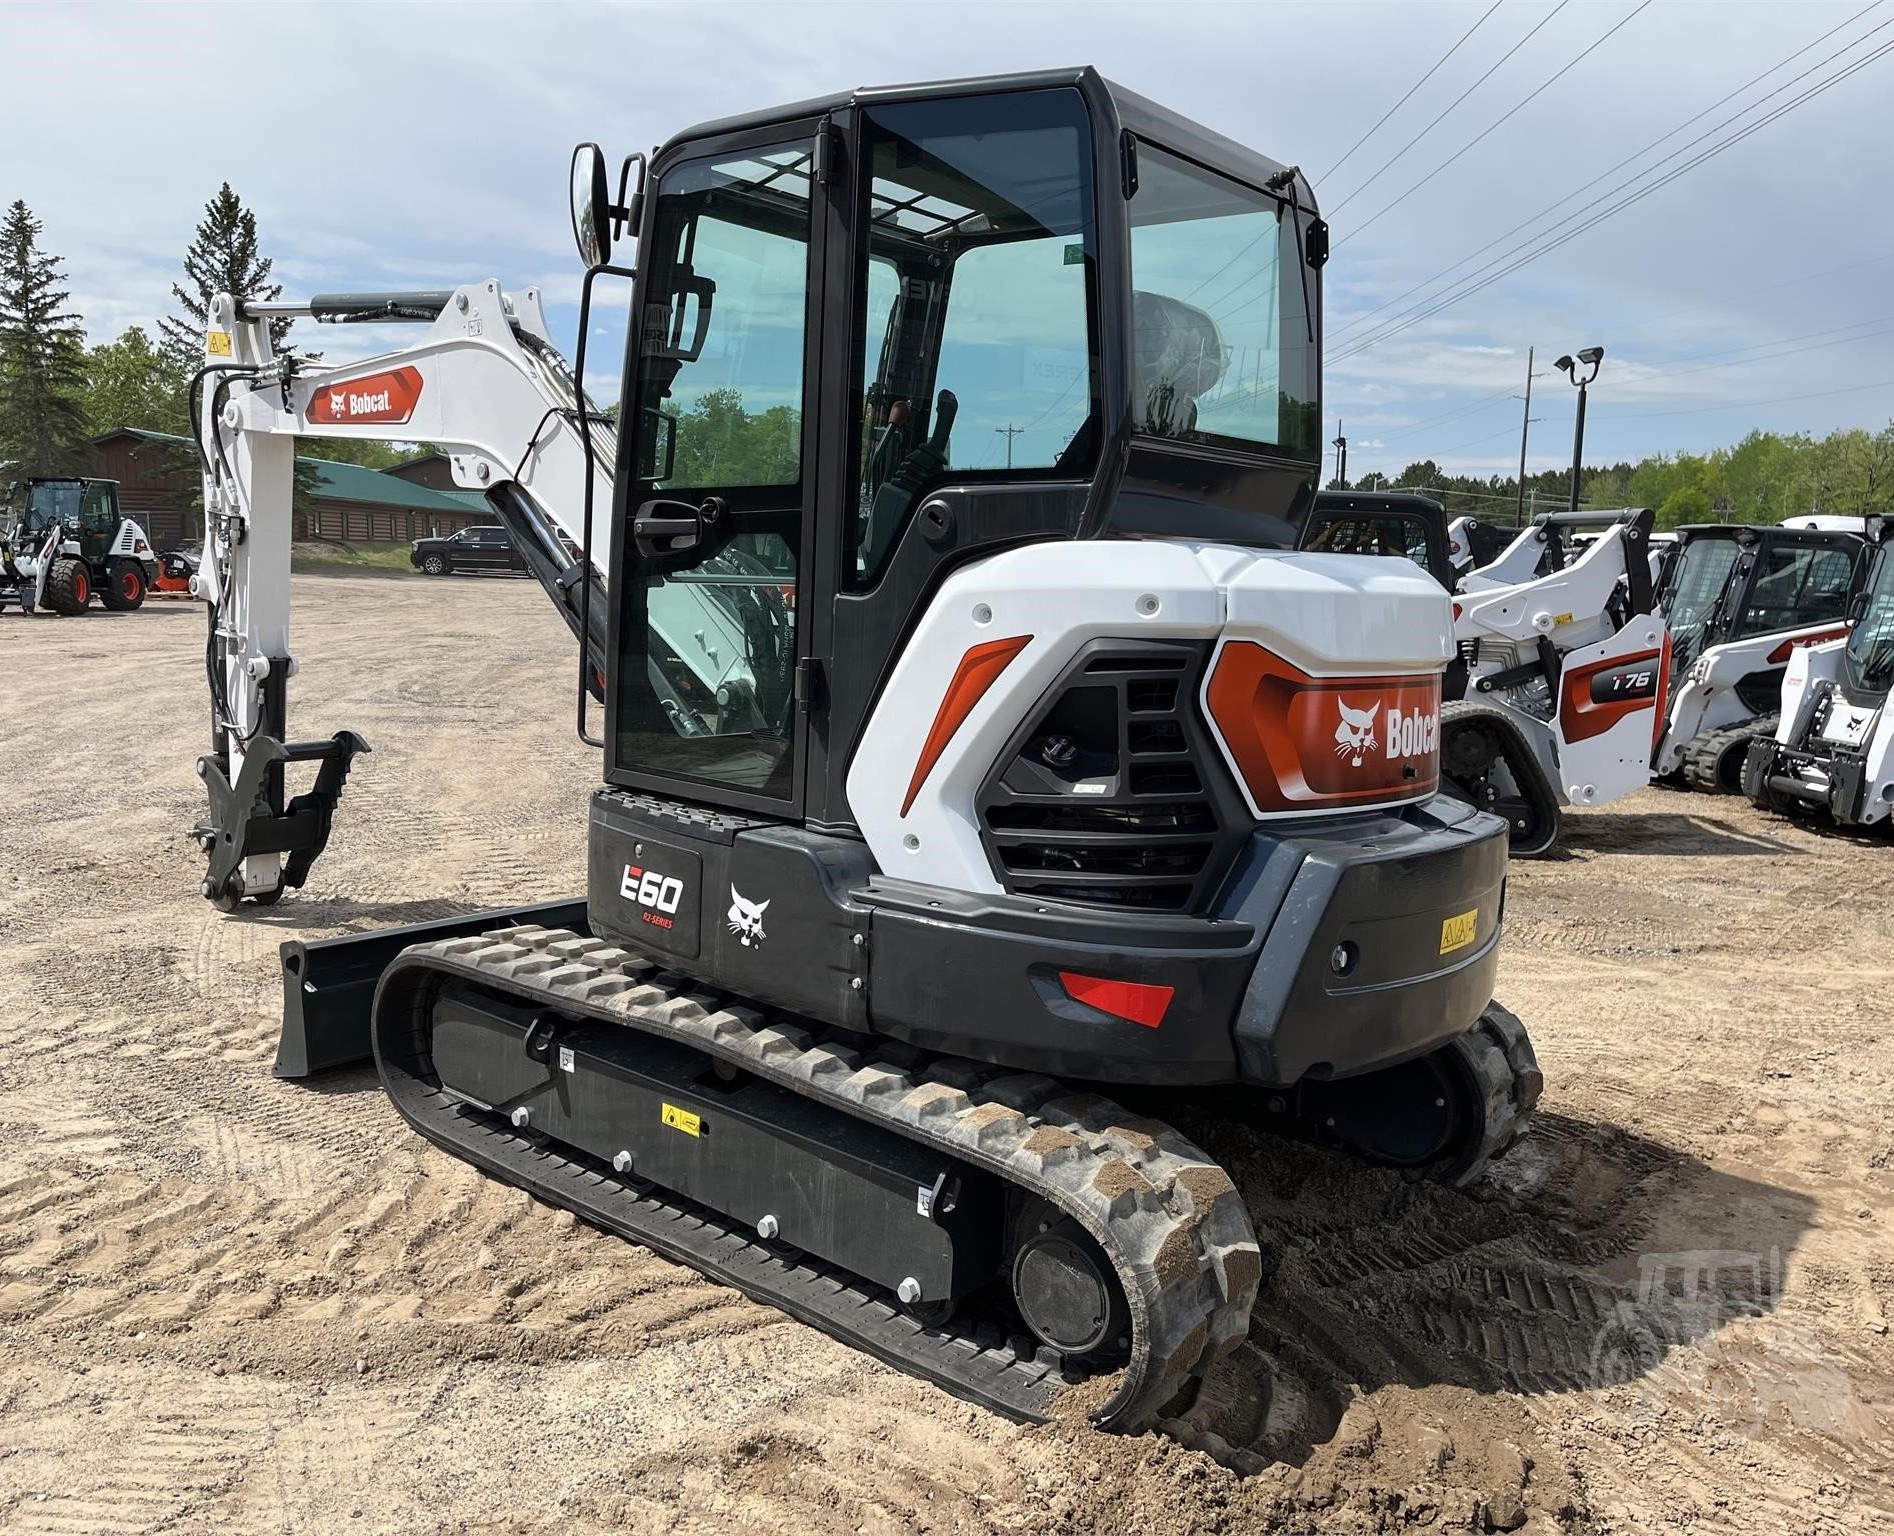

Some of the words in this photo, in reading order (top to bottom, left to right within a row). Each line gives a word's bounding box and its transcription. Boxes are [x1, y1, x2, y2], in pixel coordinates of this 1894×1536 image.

[350, 390, 390, 415] Bobcat
[1612, 672, 1651, 690] T76
[620, 864, 683, 914] E60
[642, 912, 673, 929] R2-SERIES
